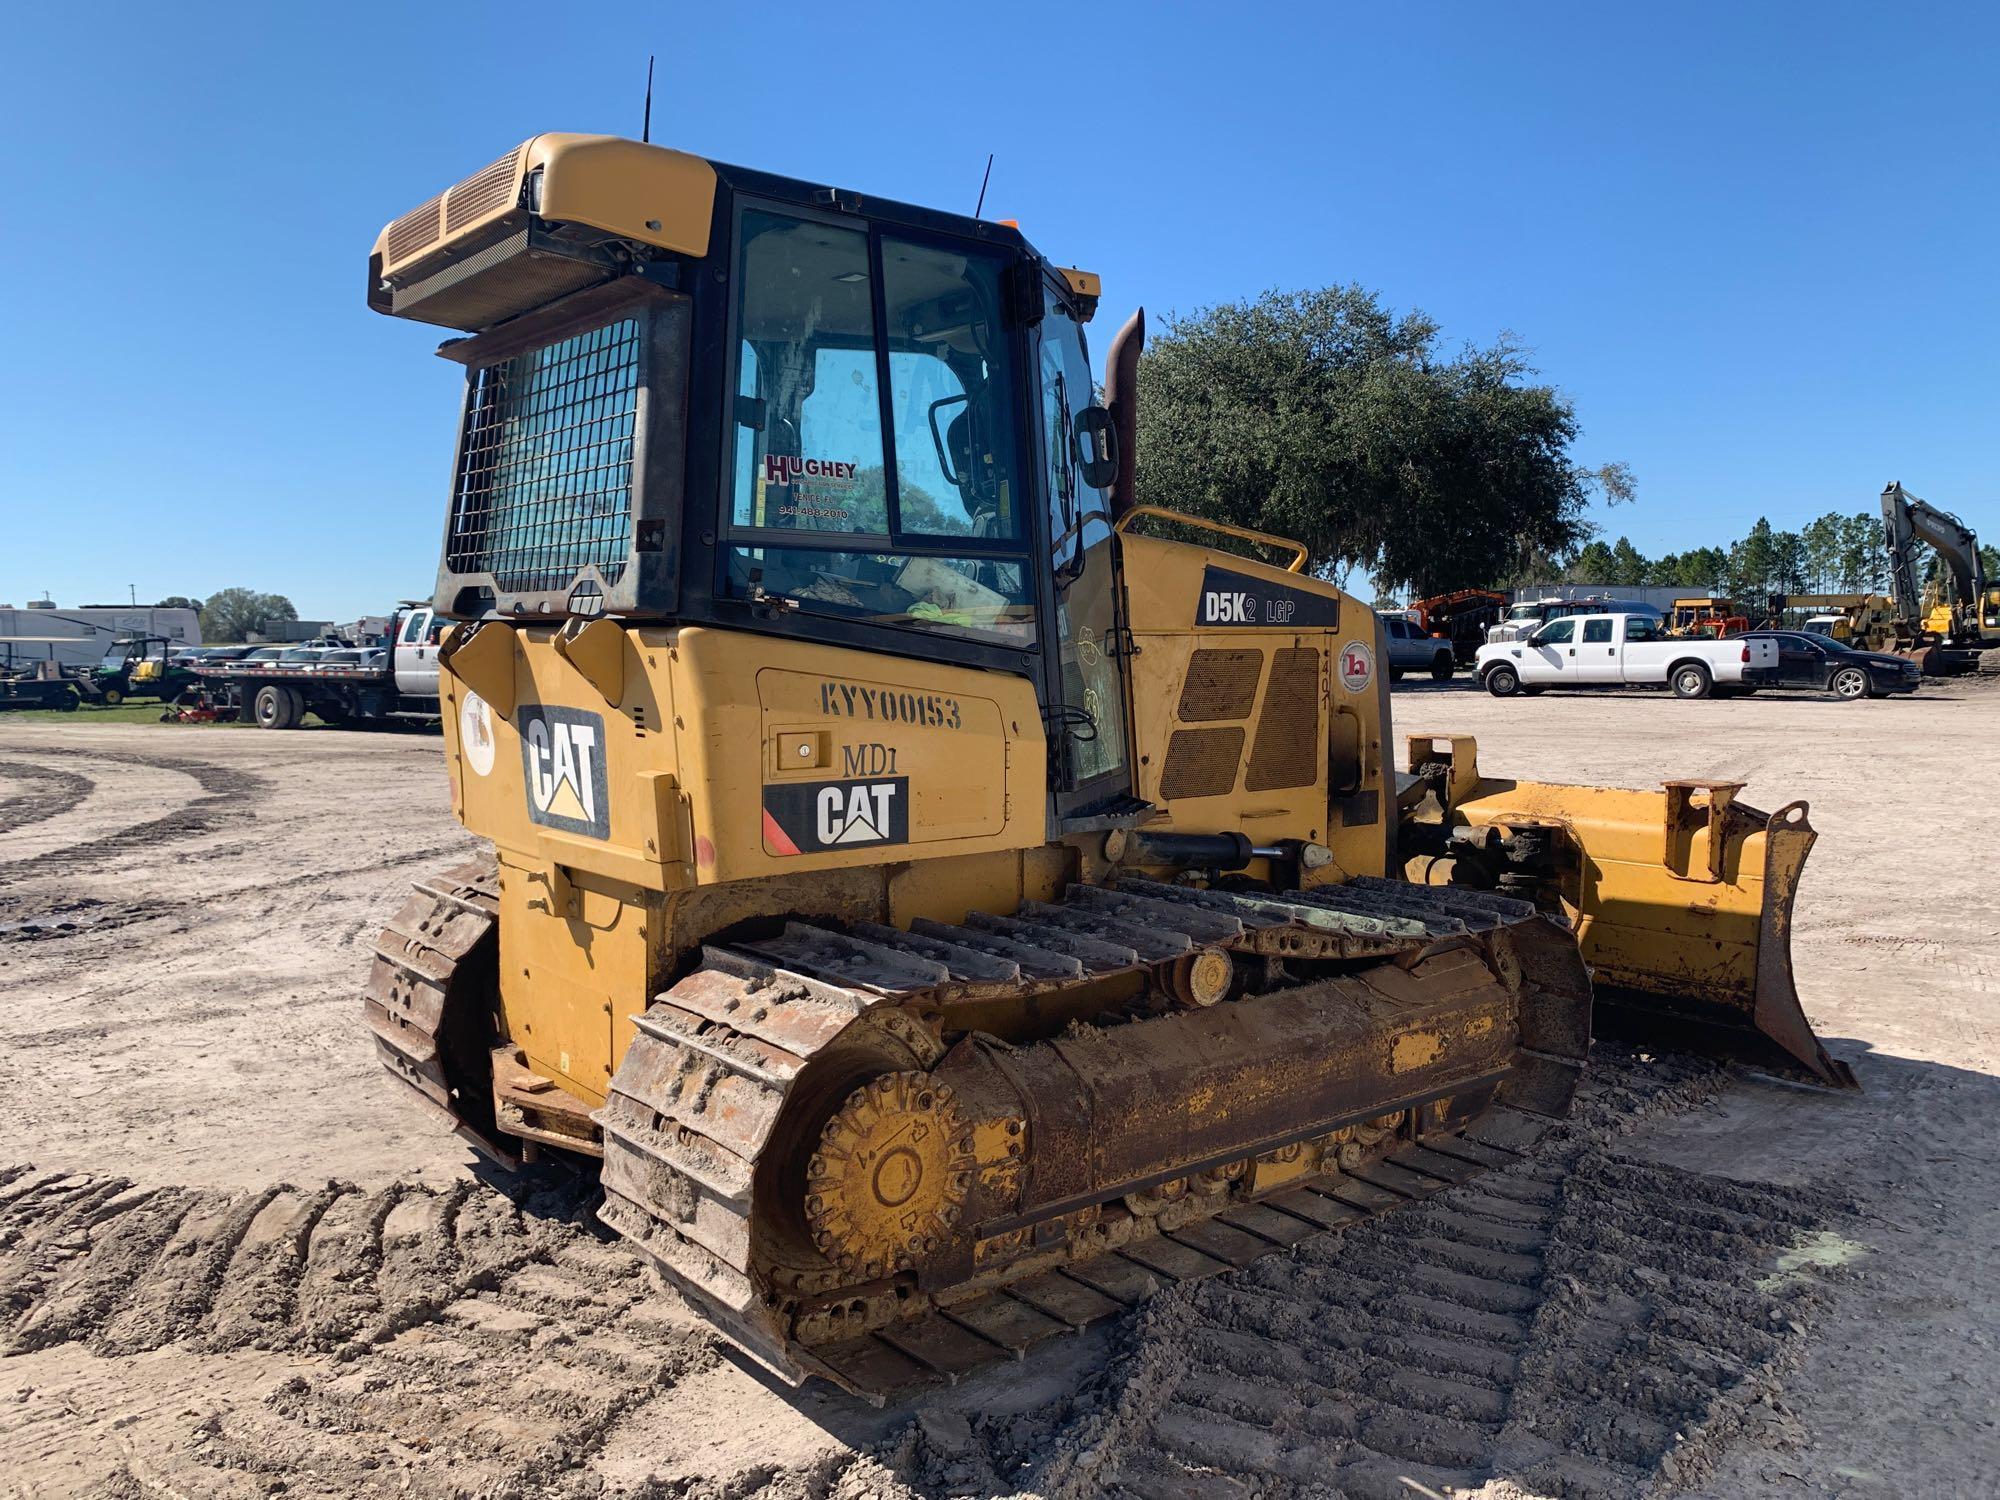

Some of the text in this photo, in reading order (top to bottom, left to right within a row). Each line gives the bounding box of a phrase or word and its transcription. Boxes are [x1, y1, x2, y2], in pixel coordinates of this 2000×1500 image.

[765, 454, 857, 486] HUGHEY
[779, 506, 849, 519] 941-488-2010
[1206, 592, 1295, 622] D5K2 LGP
[820, 682, 962, 729] KYY00153
[528, 719, 596, 822] CAT
[817, 783, 896, 845] CAT
